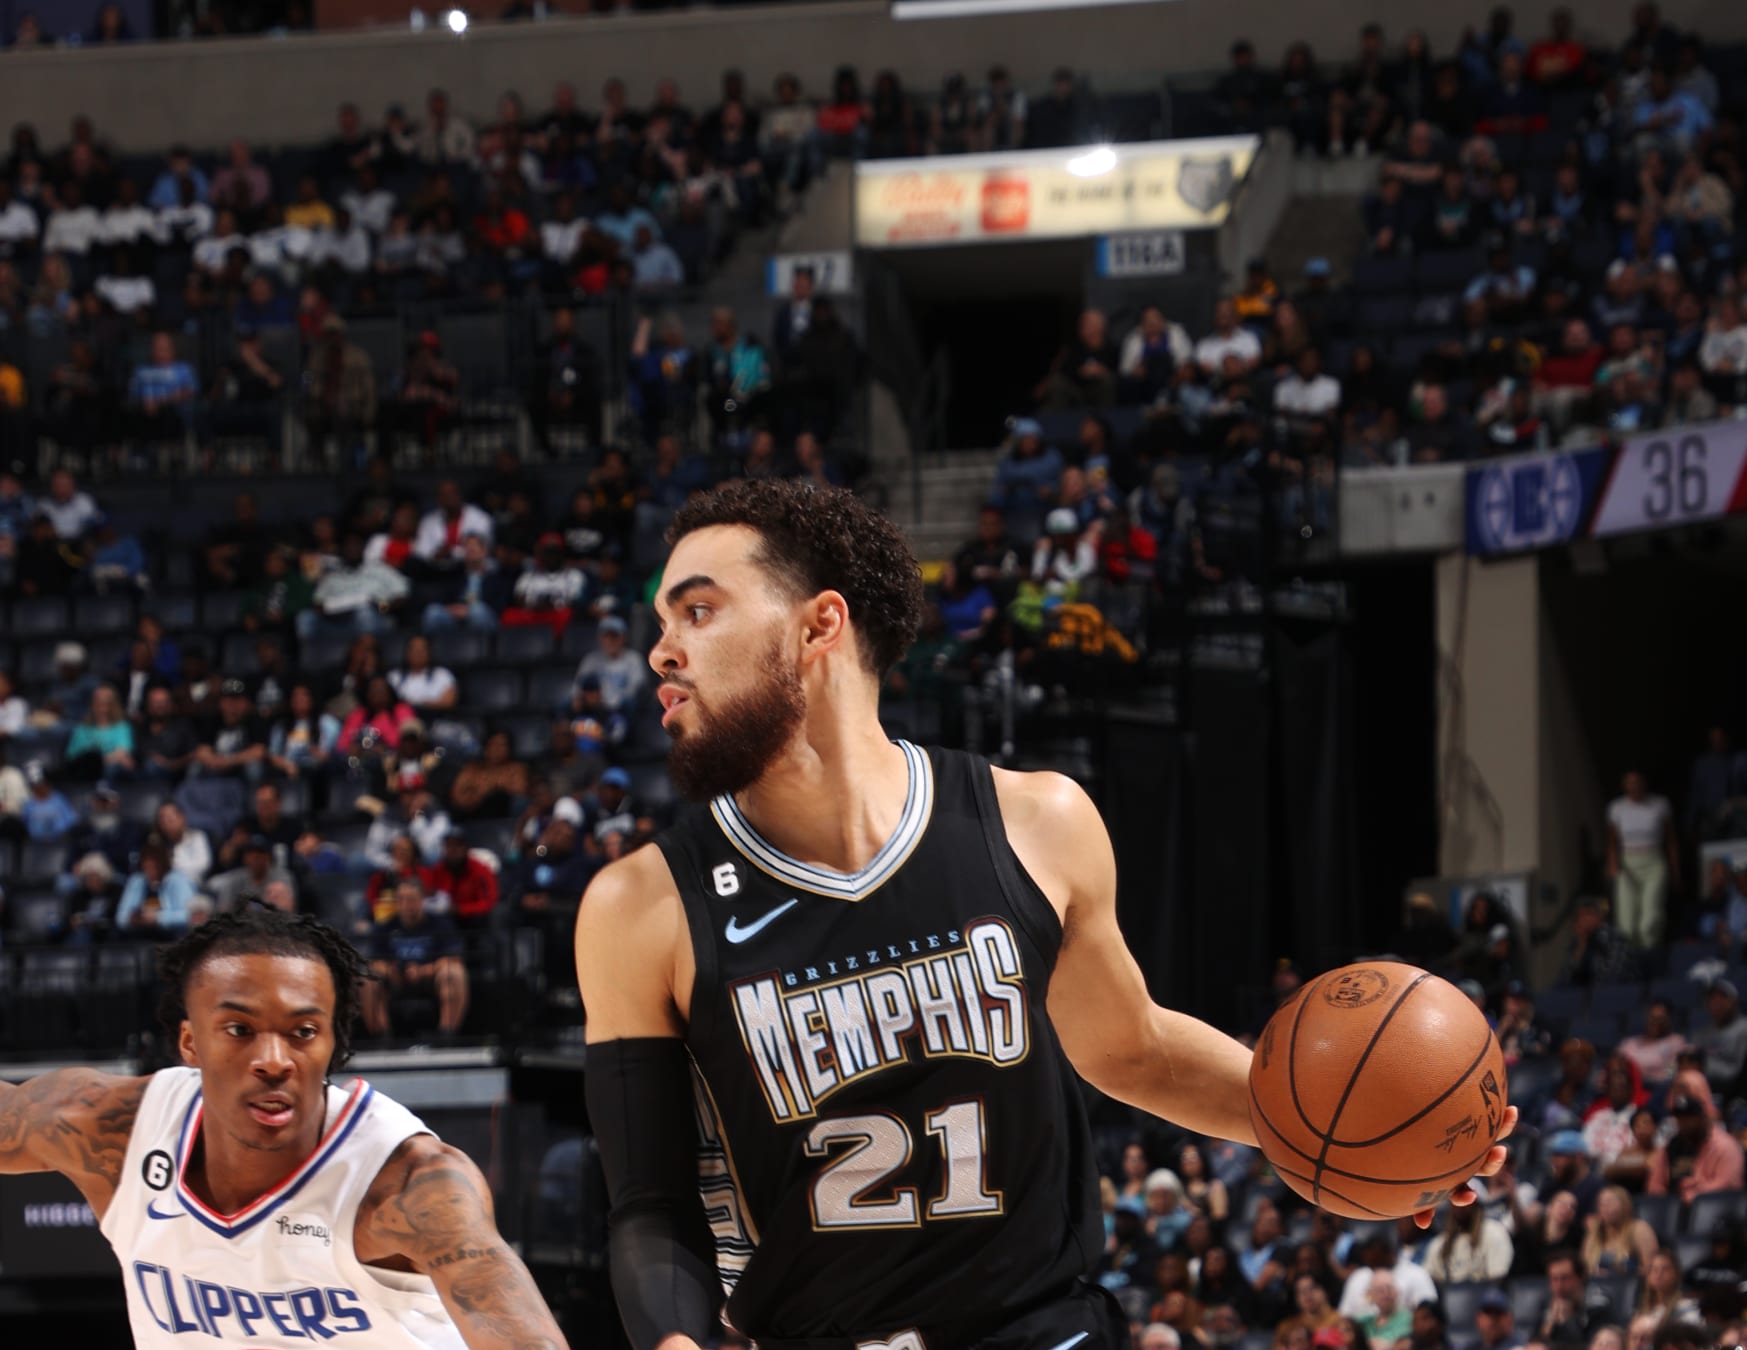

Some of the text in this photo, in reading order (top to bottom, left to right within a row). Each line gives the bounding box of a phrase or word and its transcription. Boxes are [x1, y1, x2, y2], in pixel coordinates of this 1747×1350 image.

[1643, 435, 1708, 518] 36
[712, 862, 739, 896] 6
[785, 930, 960, 986] GRIZZLIES
[730, 916, 1030, 1124] MEMPHIS
[147, 1157, 169, 1187] 6
[804, 1099, 1003, 1231] 21
[276, 1215, 330, 1247] honey
[132, 1260, 372, 1340] CLIPPERS
